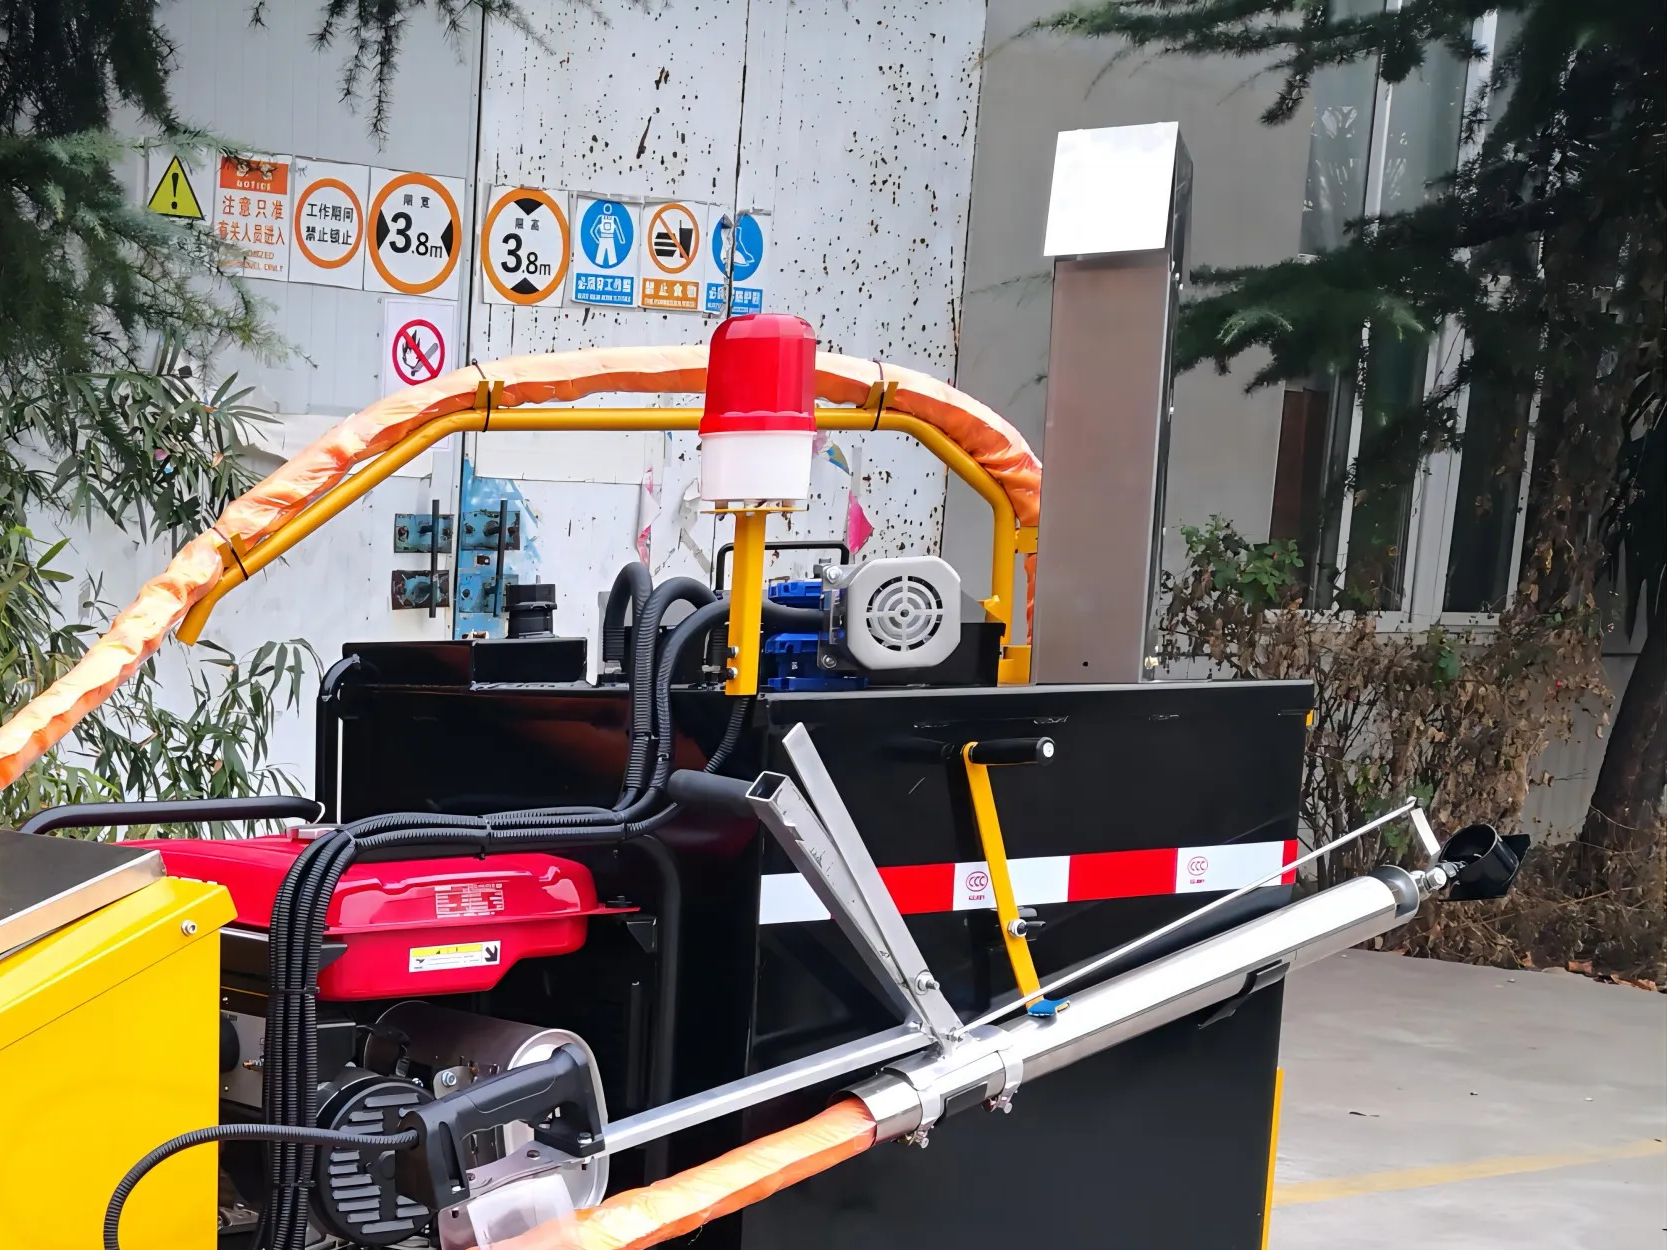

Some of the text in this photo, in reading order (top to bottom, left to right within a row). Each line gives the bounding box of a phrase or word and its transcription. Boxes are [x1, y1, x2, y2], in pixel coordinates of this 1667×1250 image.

[306, 203, 354, 223] 工作期间
[389, 211, 443, 259] 3.8m
[501, 232, 551, 276] 3.8m
